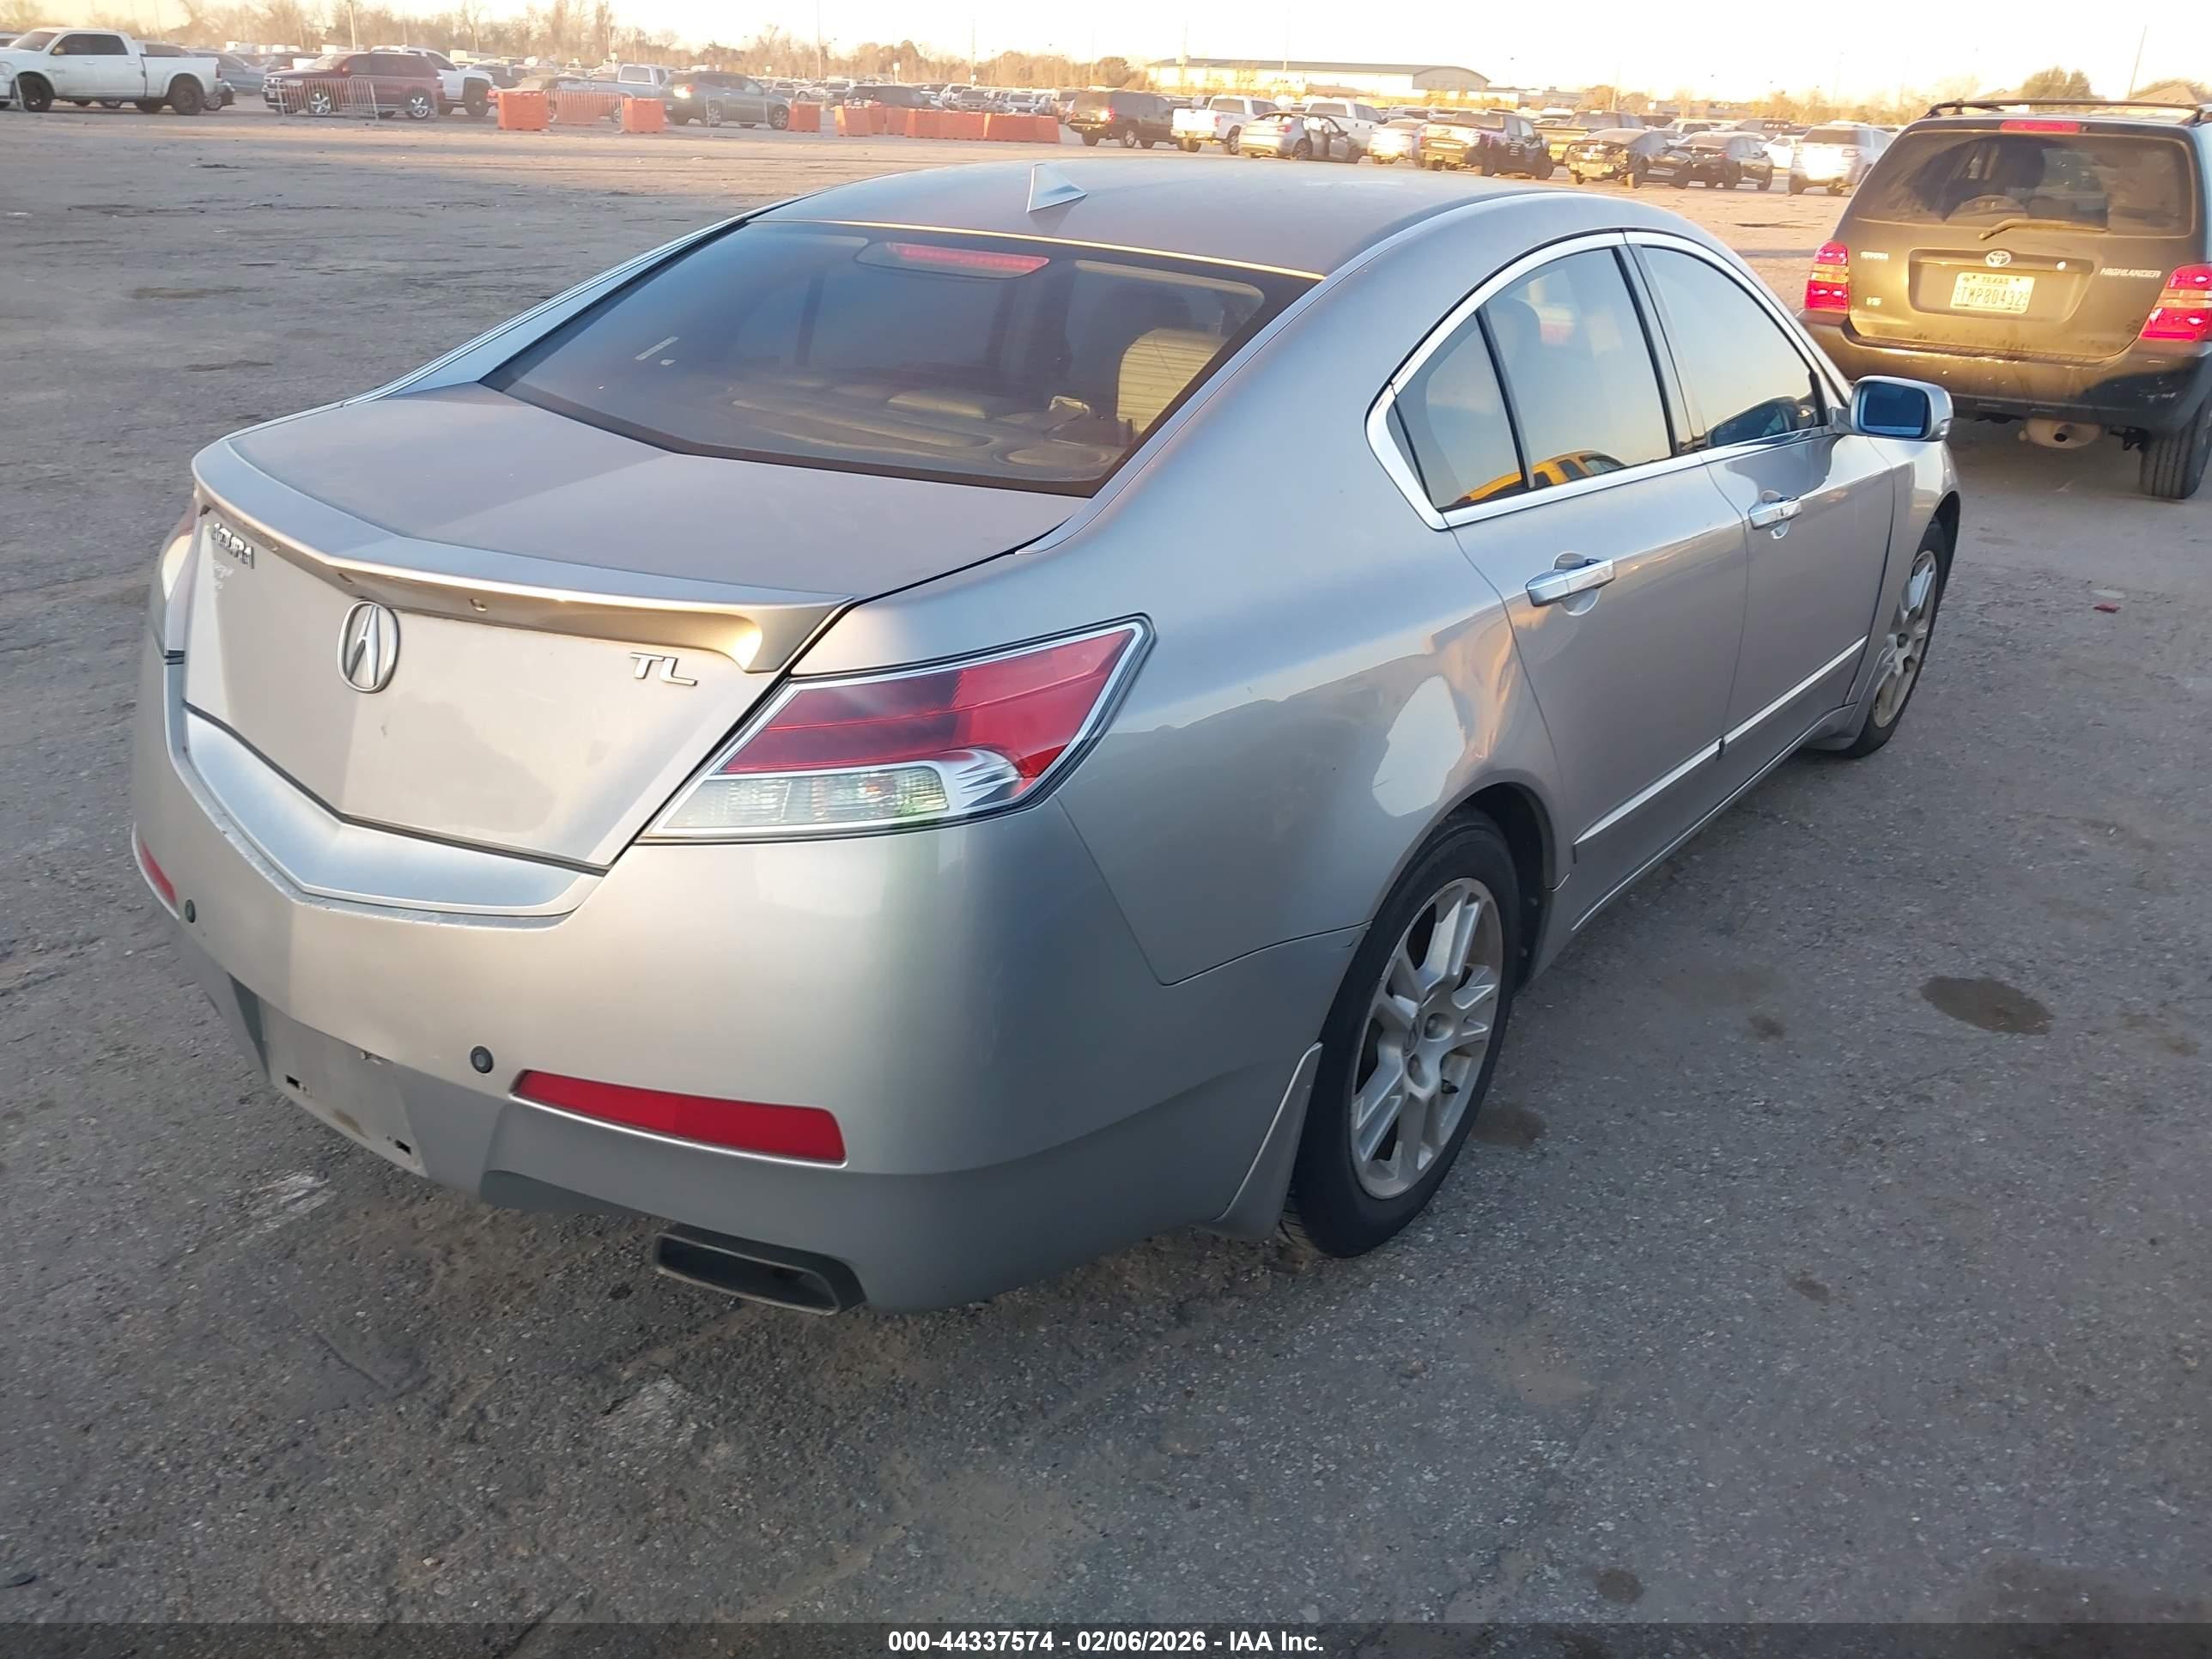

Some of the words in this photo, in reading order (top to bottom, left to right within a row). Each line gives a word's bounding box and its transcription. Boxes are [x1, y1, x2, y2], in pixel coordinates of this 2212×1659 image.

[2100, 267, 2162, 279] HIGHLANDER
[1982, 276, 2010, 285] TEXAS
[629, 652, 699, 687] TL
